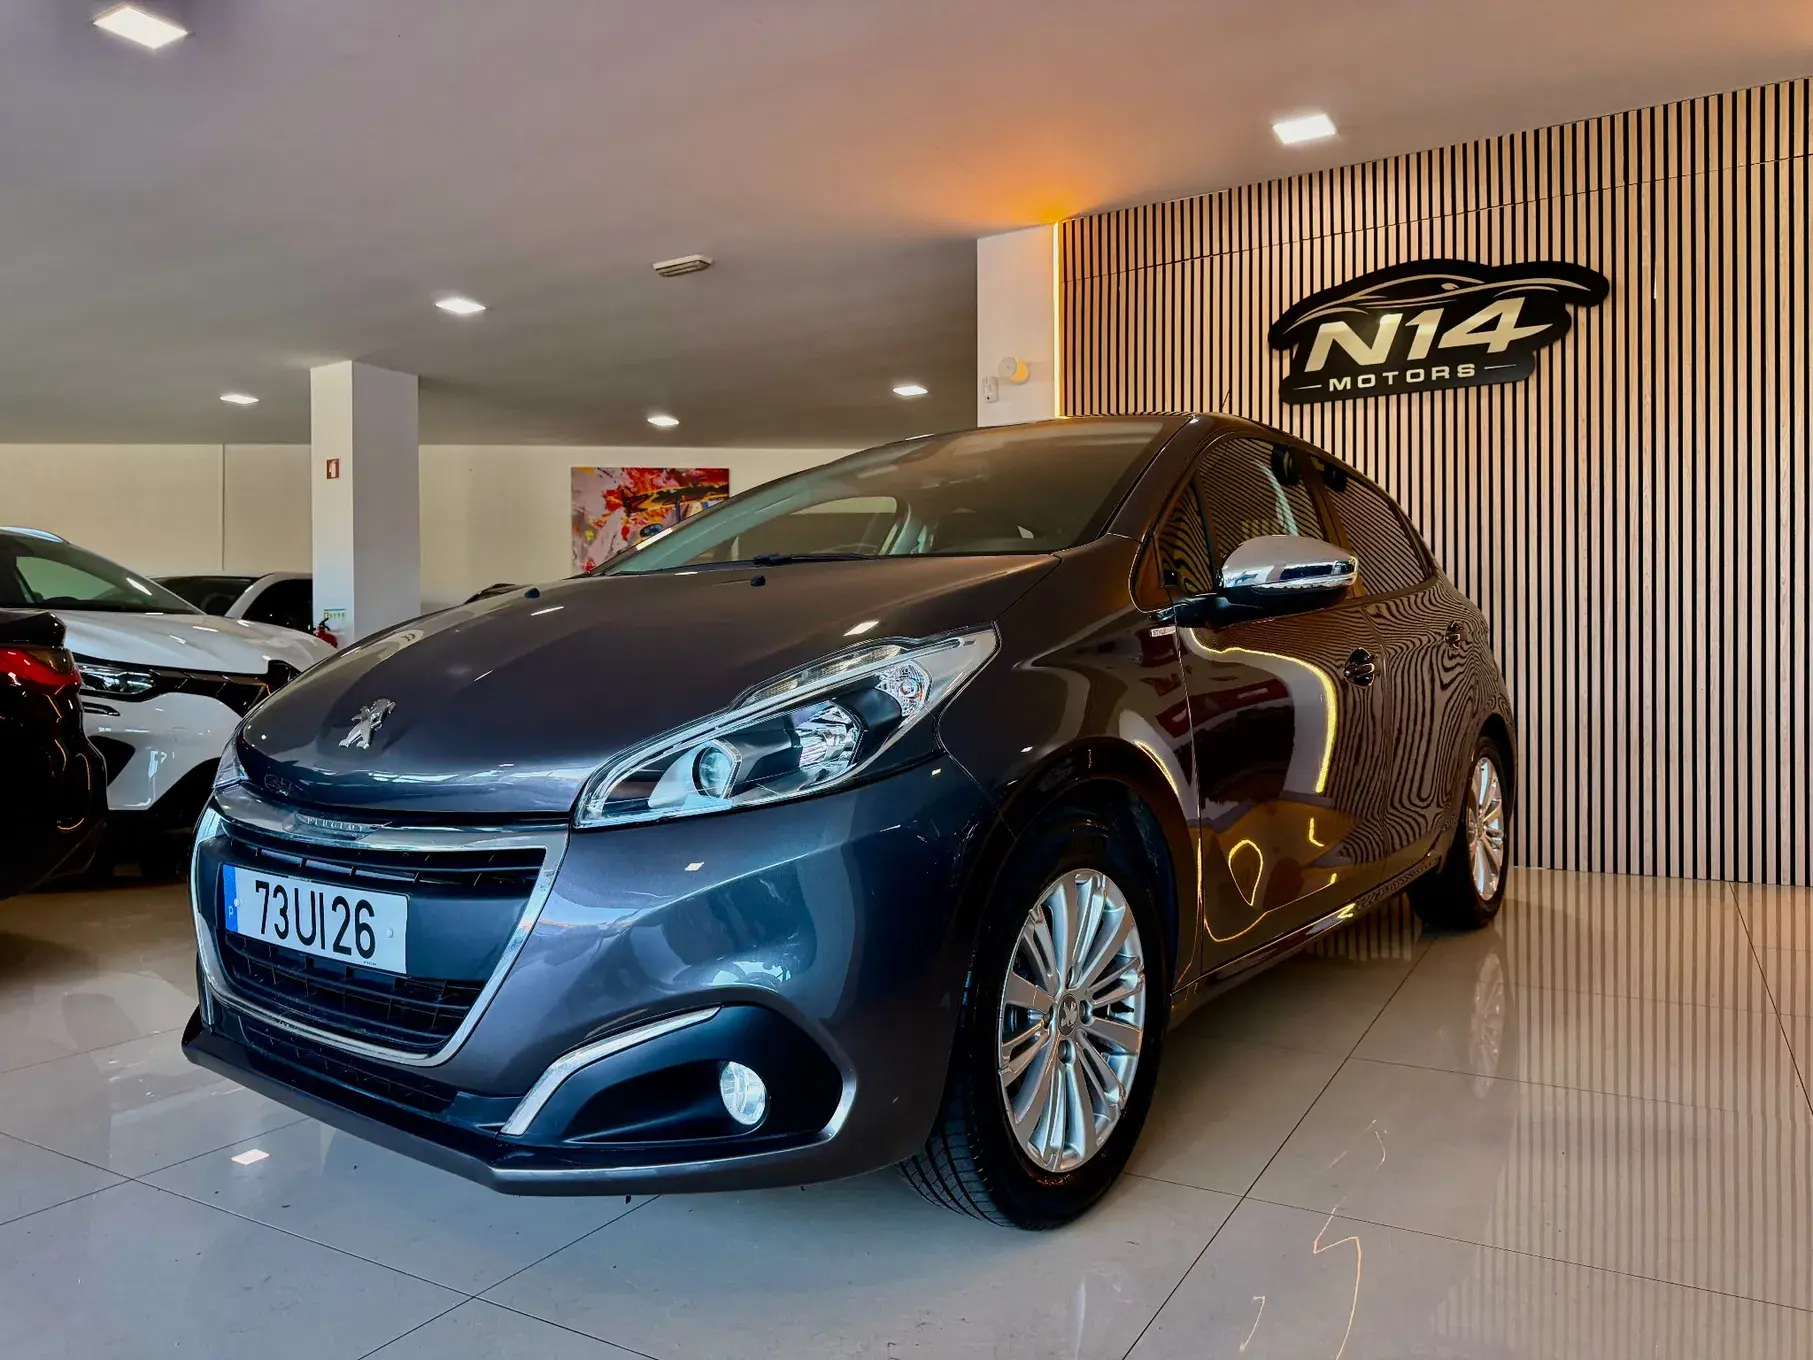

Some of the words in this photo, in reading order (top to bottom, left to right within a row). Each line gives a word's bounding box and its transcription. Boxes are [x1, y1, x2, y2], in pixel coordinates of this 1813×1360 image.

[1304, 297, 1553, 373] N14
[1329, 364, 1476, 391] MOTORS
[228, 905, 234, 918] P
[255, 879, 376, 959] 73UI26
